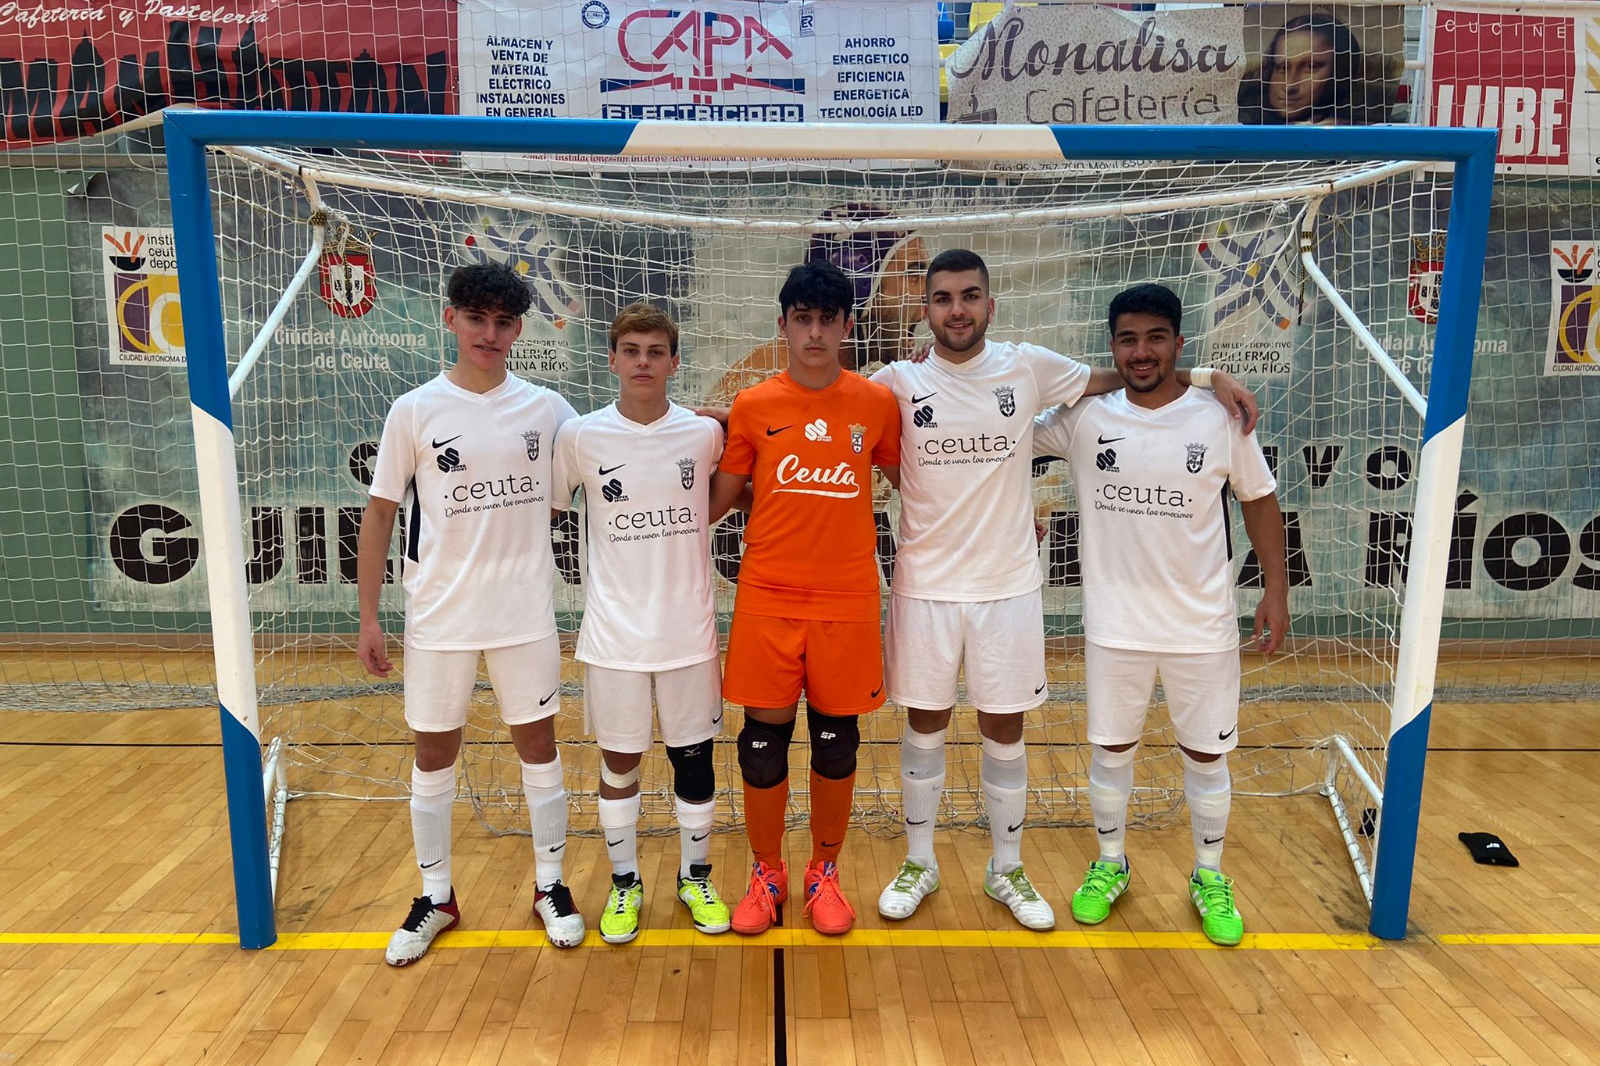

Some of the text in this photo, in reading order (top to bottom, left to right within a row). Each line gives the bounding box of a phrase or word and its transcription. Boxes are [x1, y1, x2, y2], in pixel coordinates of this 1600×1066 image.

[119, 10, 134, 28] y
[1445, 20, 1565, 39] CUCINE
[487, 36, 553, 50] ALMACEN Y
[618, 10, 793, 76] CAPA
[845, 38, 895, 48] AHORRO
[951, 17, 1239, 82] Monalisa
[492, 50, 548, 63] VENTA DE
[833, 53, 909, 65] ENERGETICO
[492, 65, 548, 76] MATERIAL
[838, 71, 905, 83] EFICIENCIA
[489, 76, 551, 90] ELÉCTRICO
[476, 93, 565, 104] INSTALACIONES
[1026, 84, 1221, 124] Cafetería
[486, 107, 556, 117] EN GENERAL
[820, 104, 923, 119] TECNOLOGÍA LED
[147, 234, 176, 245] insti
[149, 248, 176, 257] ceut
[150, 259, 178, 271] depo
[275, 328, 427, 346] Ciudad Autónoma
[144, 354, 180, 362] AUTÓNOMA
[315, 353, 390, 370] de Ceuta
[541, 359, 568, 372] RÍOS
[1262, 360, 1291, 373] RÍOS
[918, 458, 942, 467] Donde
[774, 454, 858, 488] Ceuta
[444, 504, 472, 518] Donde
[1095, 501, 1117, 511] Donde
[821, 731, 836, 739] SP
[752, 741, 768, 749] SP
